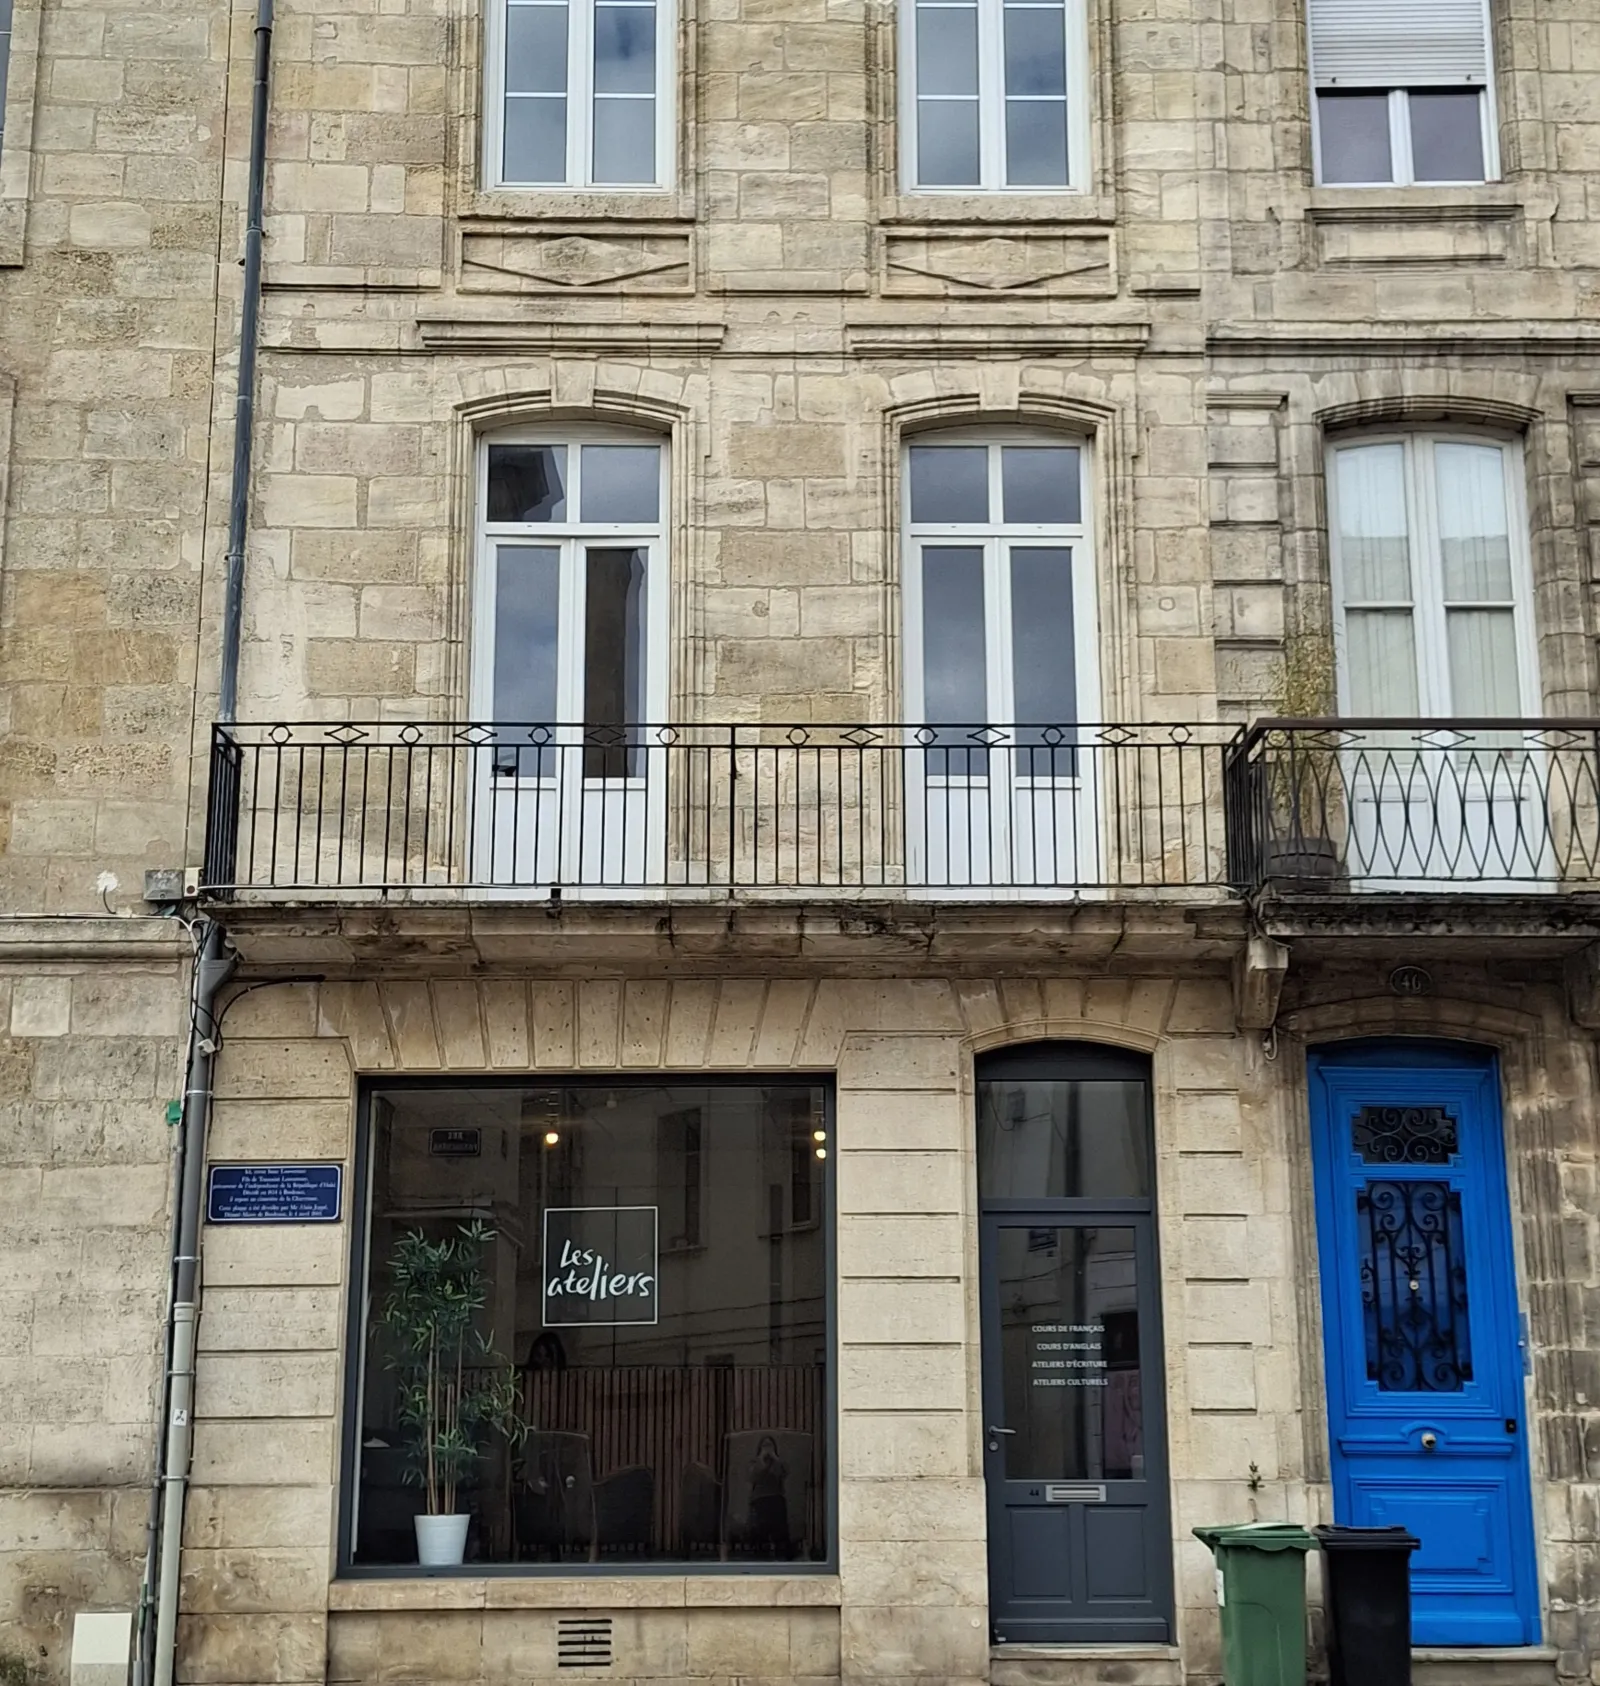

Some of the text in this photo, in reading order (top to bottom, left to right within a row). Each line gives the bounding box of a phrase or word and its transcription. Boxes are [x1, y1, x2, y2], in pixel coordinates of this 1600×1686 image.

[560, 1238, 595, 1269] Les
[547, 1254, 655, 1301] ateliers
[1069, 1325, 1106, 1334] FRANÇAIS
[1031, 1359, 1108, 1368] ATELIERS D'ÉCRITURE
[1033, 1378, 1109, 1386] ATELIERS CULTURELS
